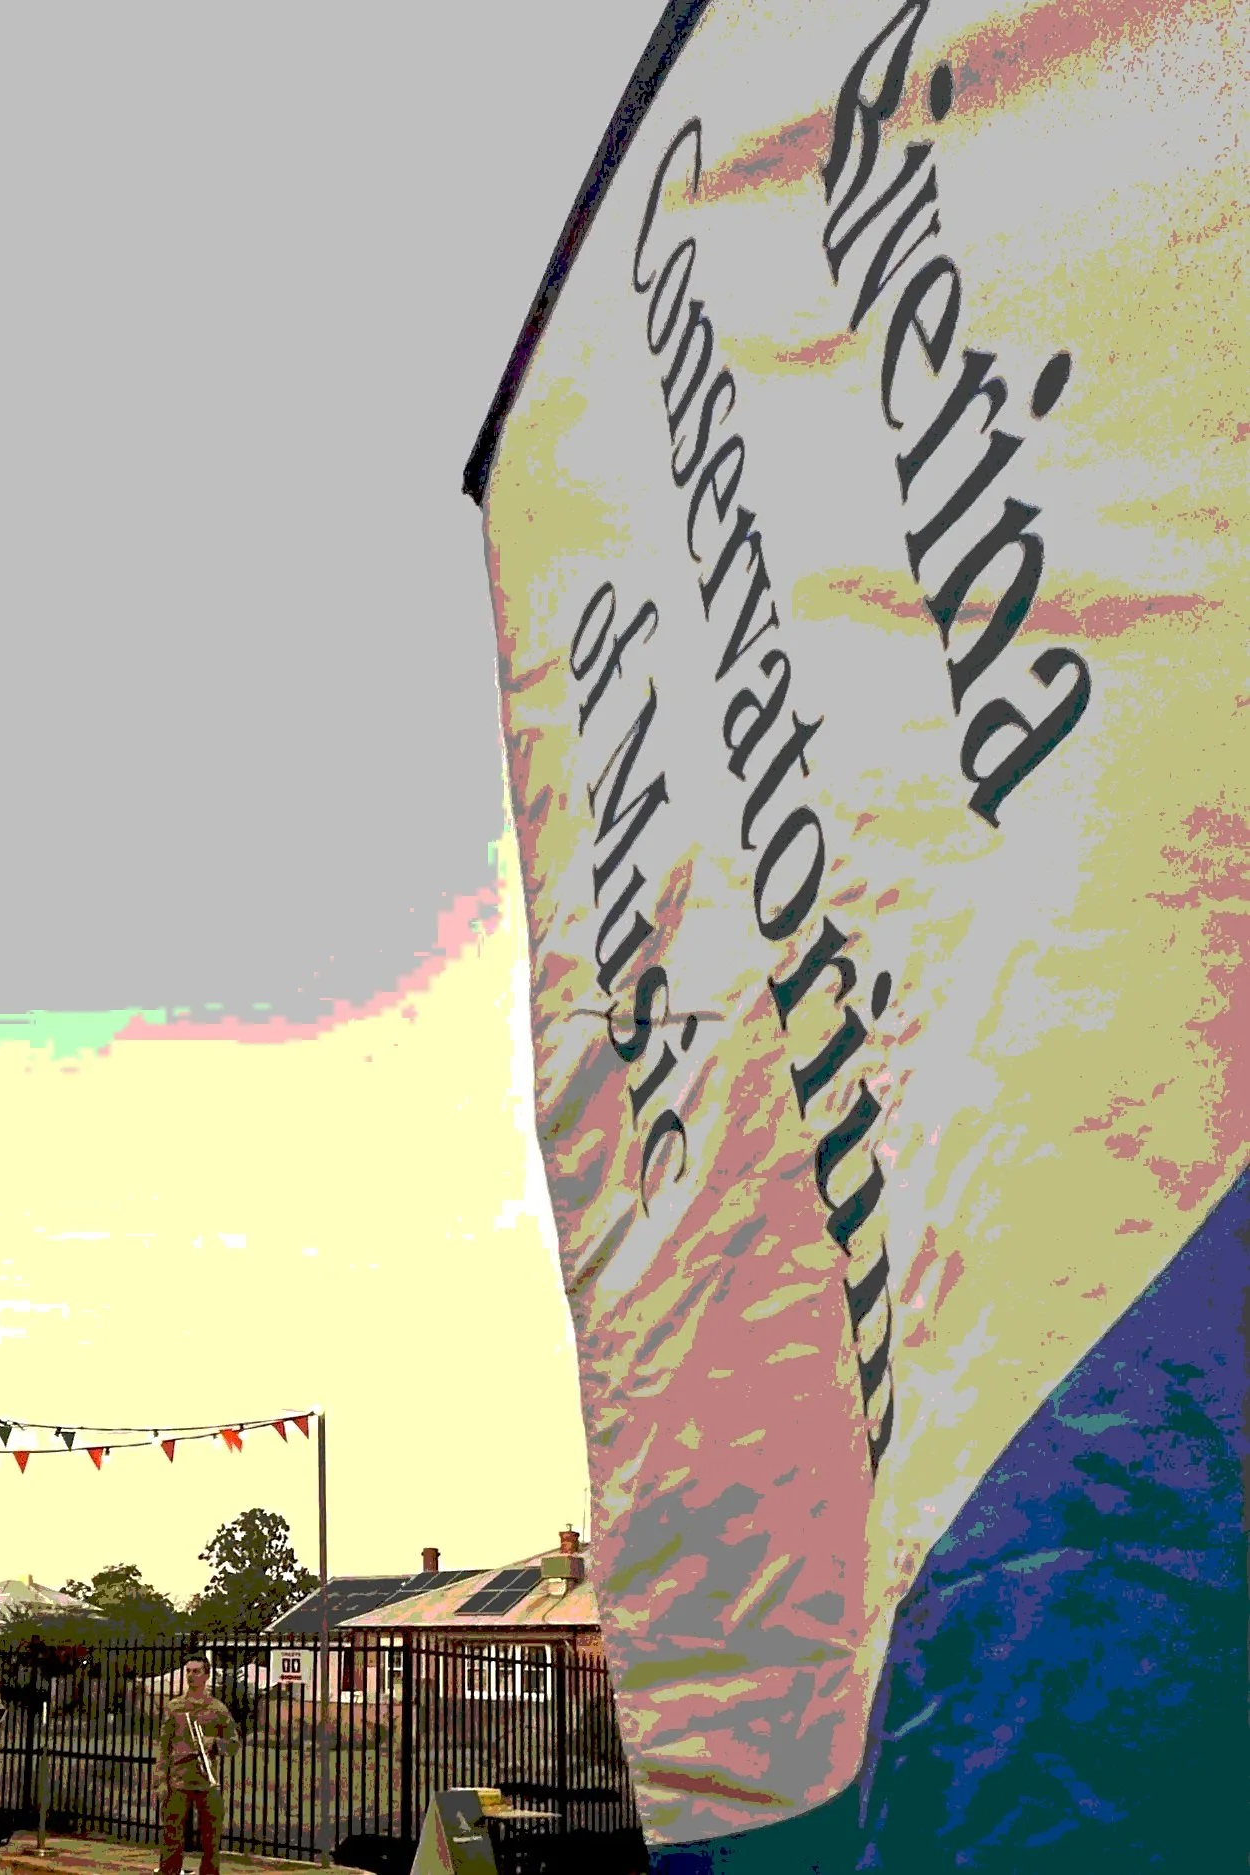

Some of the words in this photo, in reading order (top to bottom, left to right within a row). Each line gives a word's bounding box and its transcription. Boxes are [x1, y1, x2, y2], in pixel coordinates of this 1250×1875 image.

[569, 579, 659, 738] of
[821, 0, 1092, 829] Riverina
[587, 676, 698, 1219] Music
[632, 115, 895, 1479] Conservatorium
